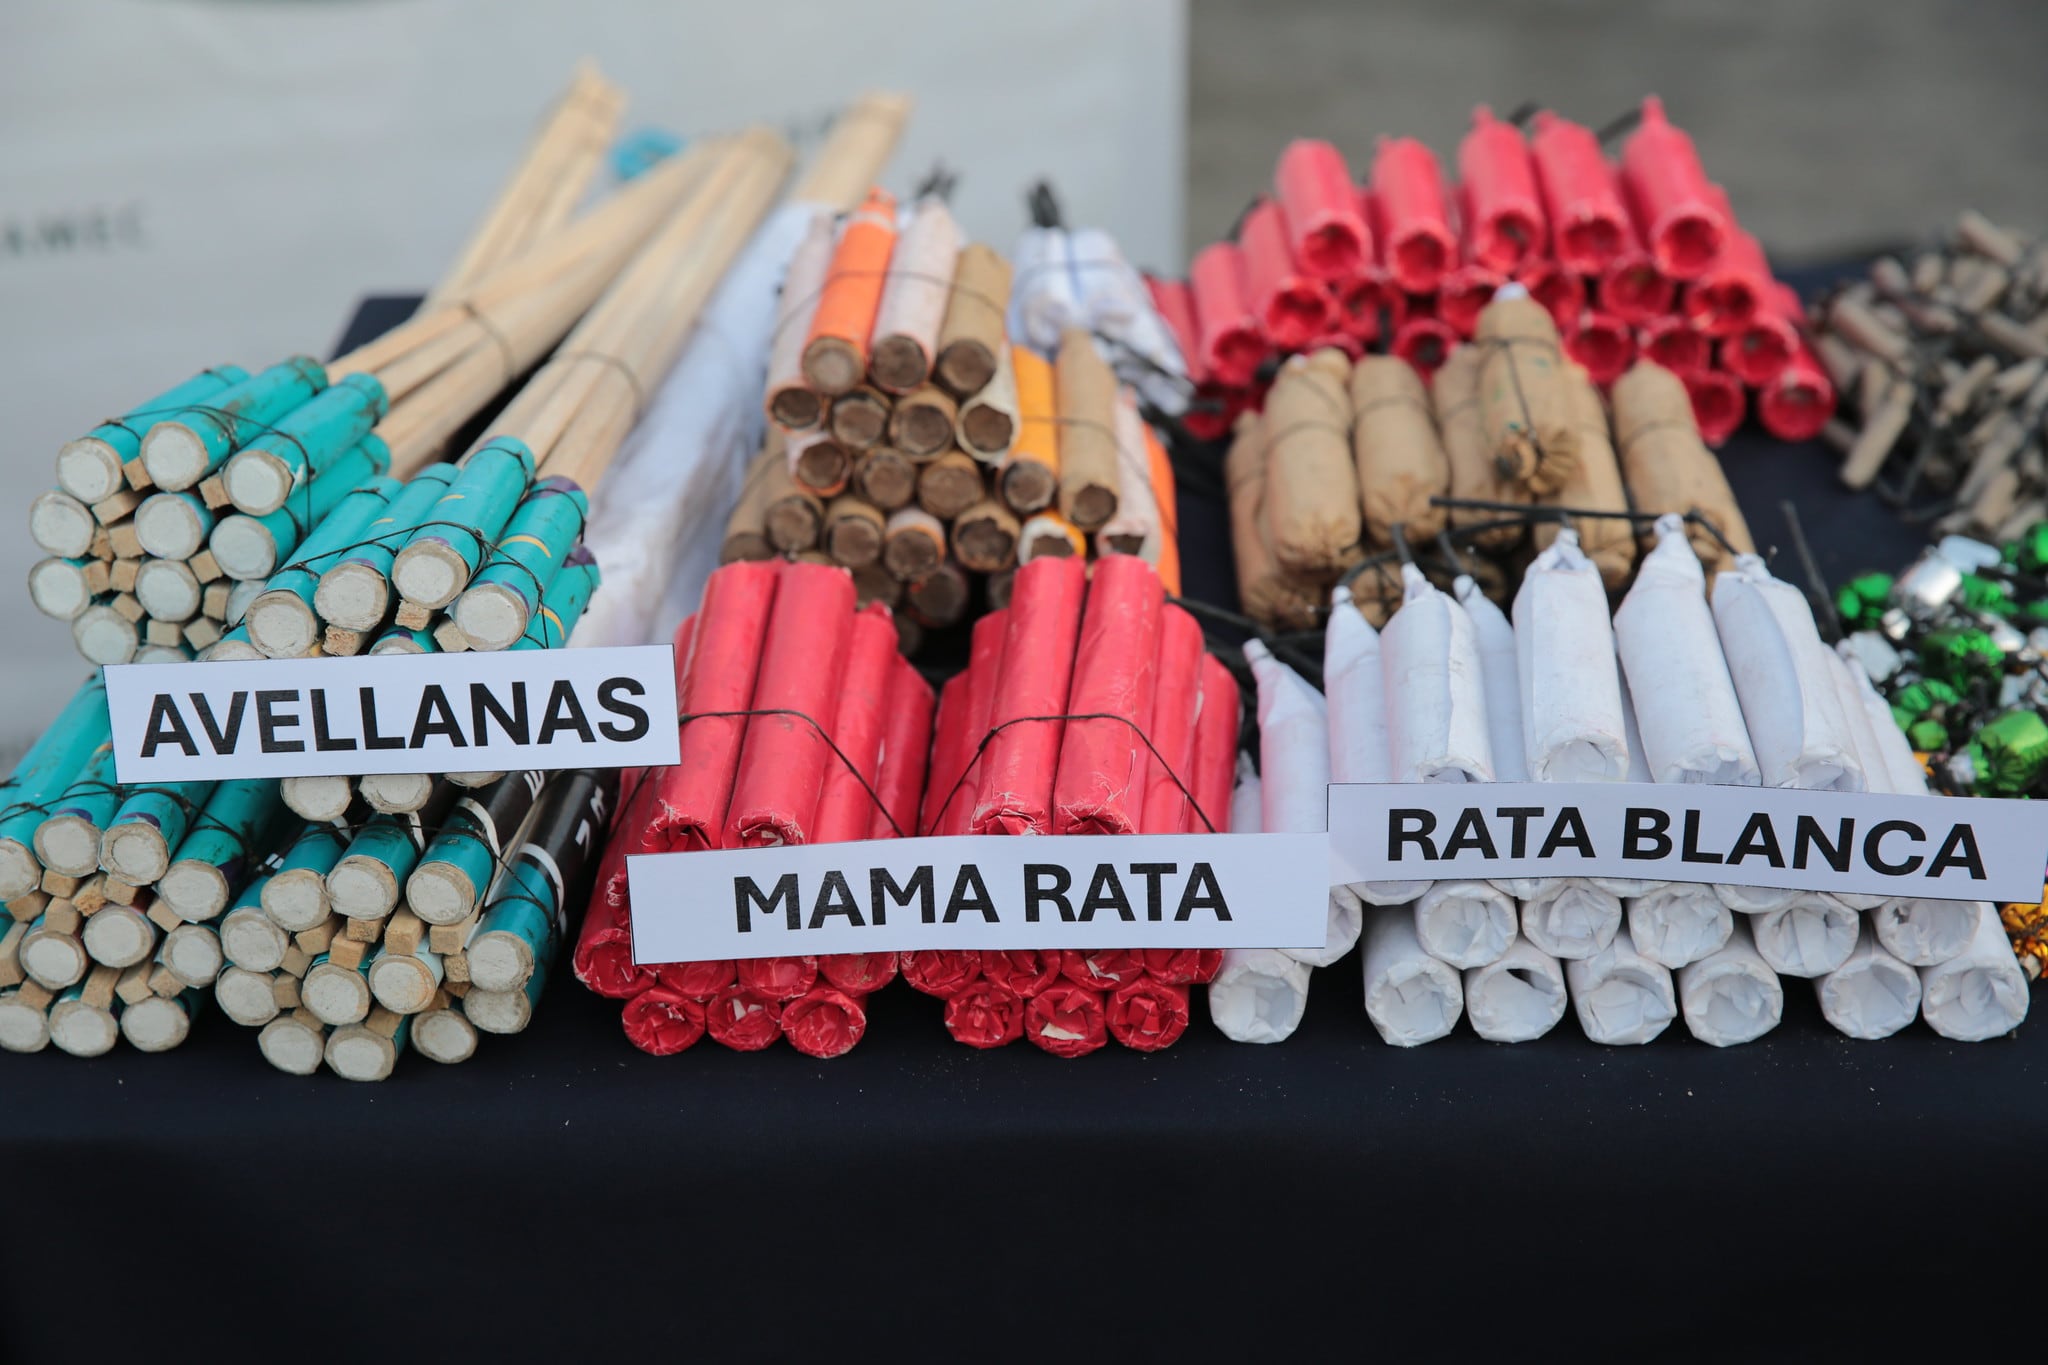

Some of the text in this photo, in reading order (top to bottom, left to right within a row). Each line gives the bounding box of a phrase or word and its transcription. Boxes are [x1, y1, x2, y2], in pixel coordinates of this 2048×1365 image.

[141, 677, 650, 758] AVELLANAS
[1388, 806, 1987, 881] RATA BLANCA
[734, 862, 1232, 933] MAMA RATA
